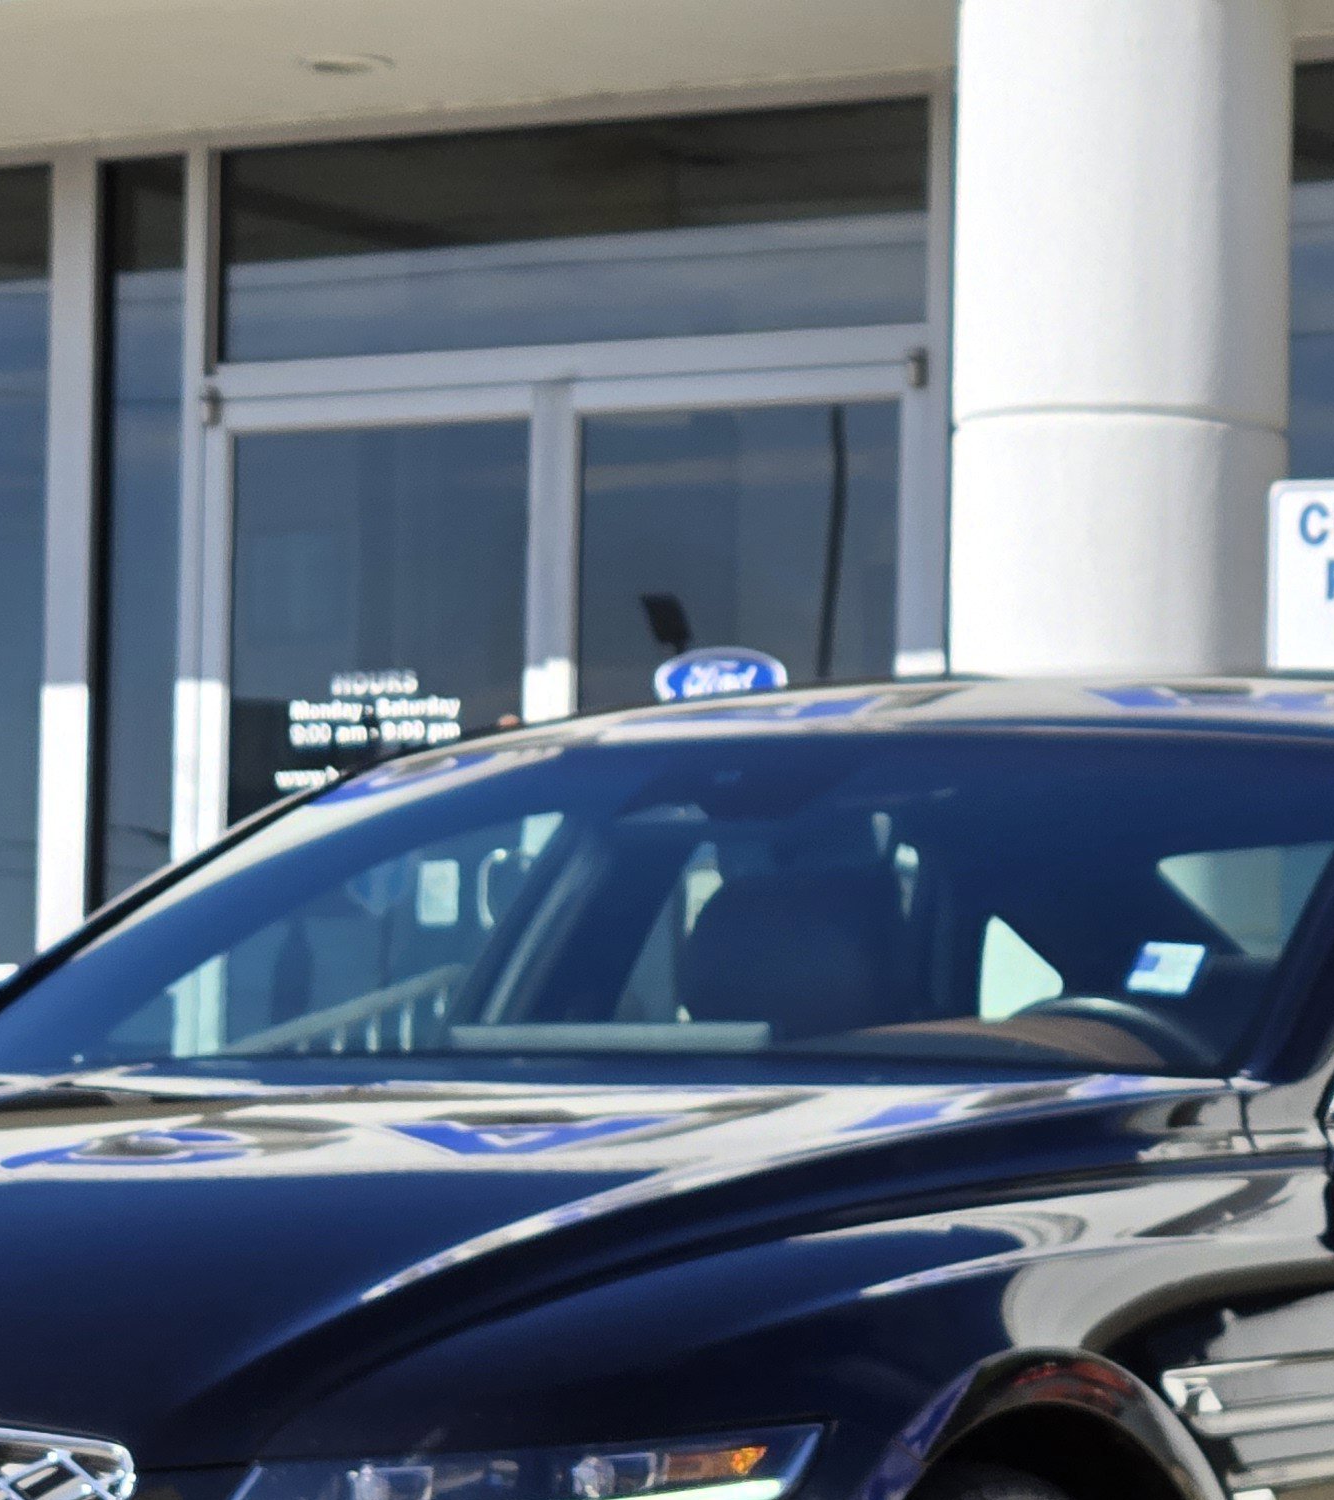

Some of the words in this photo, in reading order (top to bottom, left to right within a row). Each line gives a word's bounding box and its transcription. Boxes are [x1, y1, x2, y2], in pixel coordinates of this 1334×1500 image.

[682, 662, 757, 697] Ford
[289, 700, 363, 722] Monday
[376, 695, 461, 720] Saturday
[336, 726, 367, 744] am
[427, 722, 461, 744] pm
